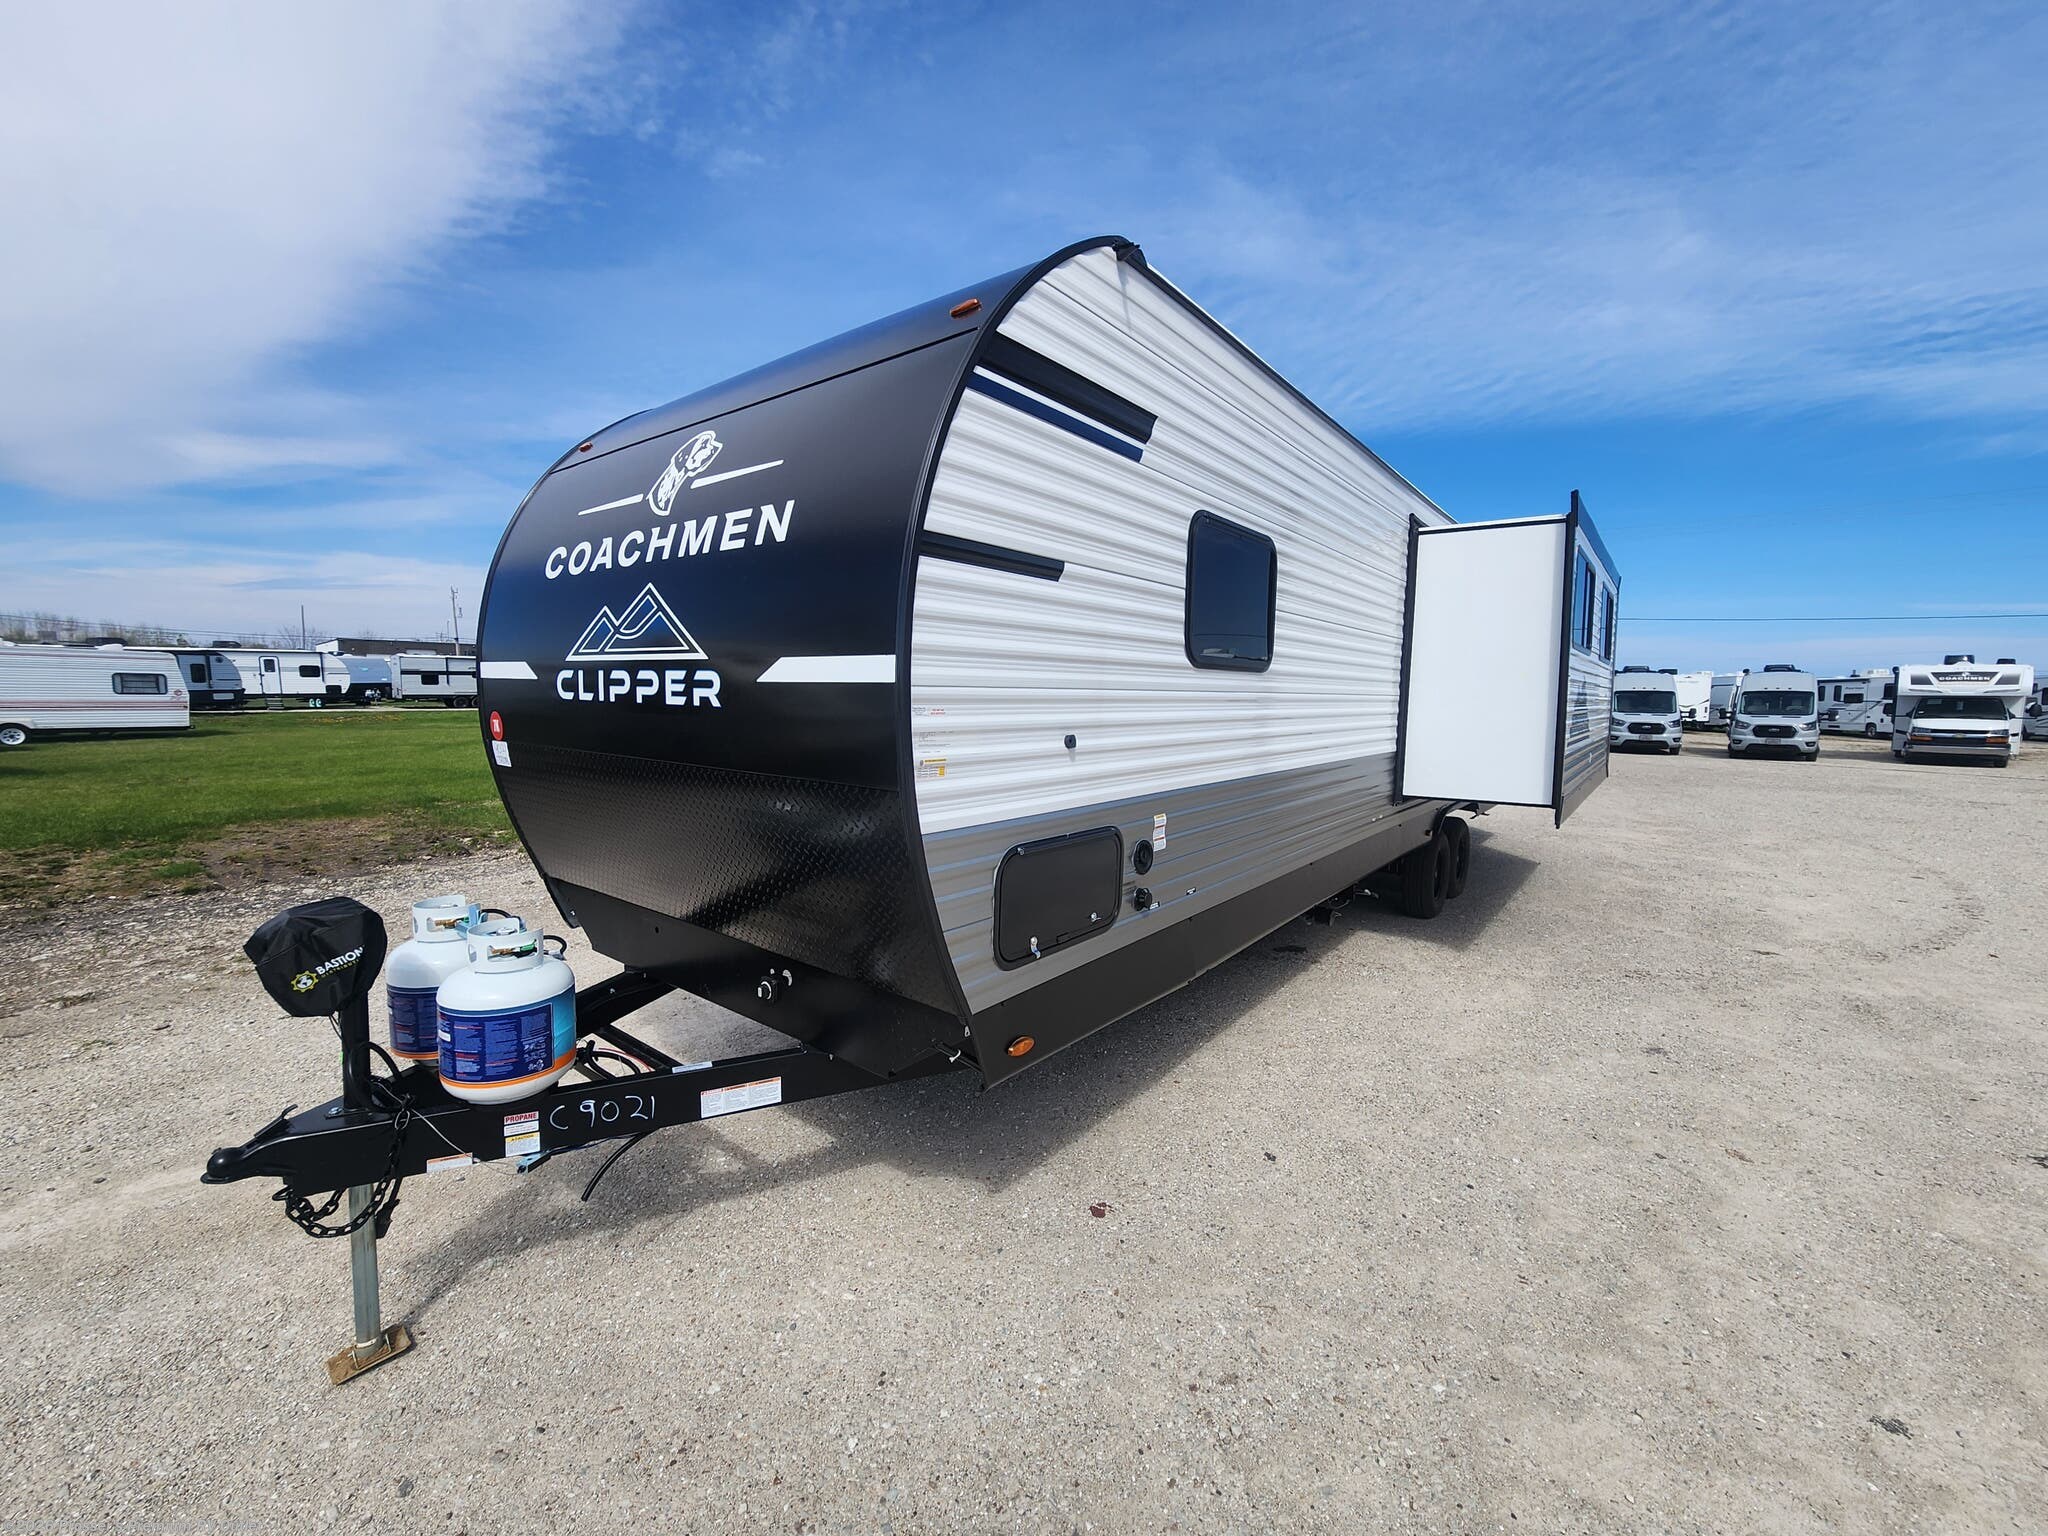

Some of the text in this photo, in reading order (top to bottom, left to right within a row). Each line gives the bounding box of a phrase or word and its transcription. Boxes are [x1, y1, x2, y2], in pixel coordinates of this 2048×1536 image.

[545, 500, 795, 580] COACHMEN
[556, 669, 721, 708] CLIPPER
[315, 946, 364, 975] BASTION
[505, 1112, 537, 1123] PROPANE
